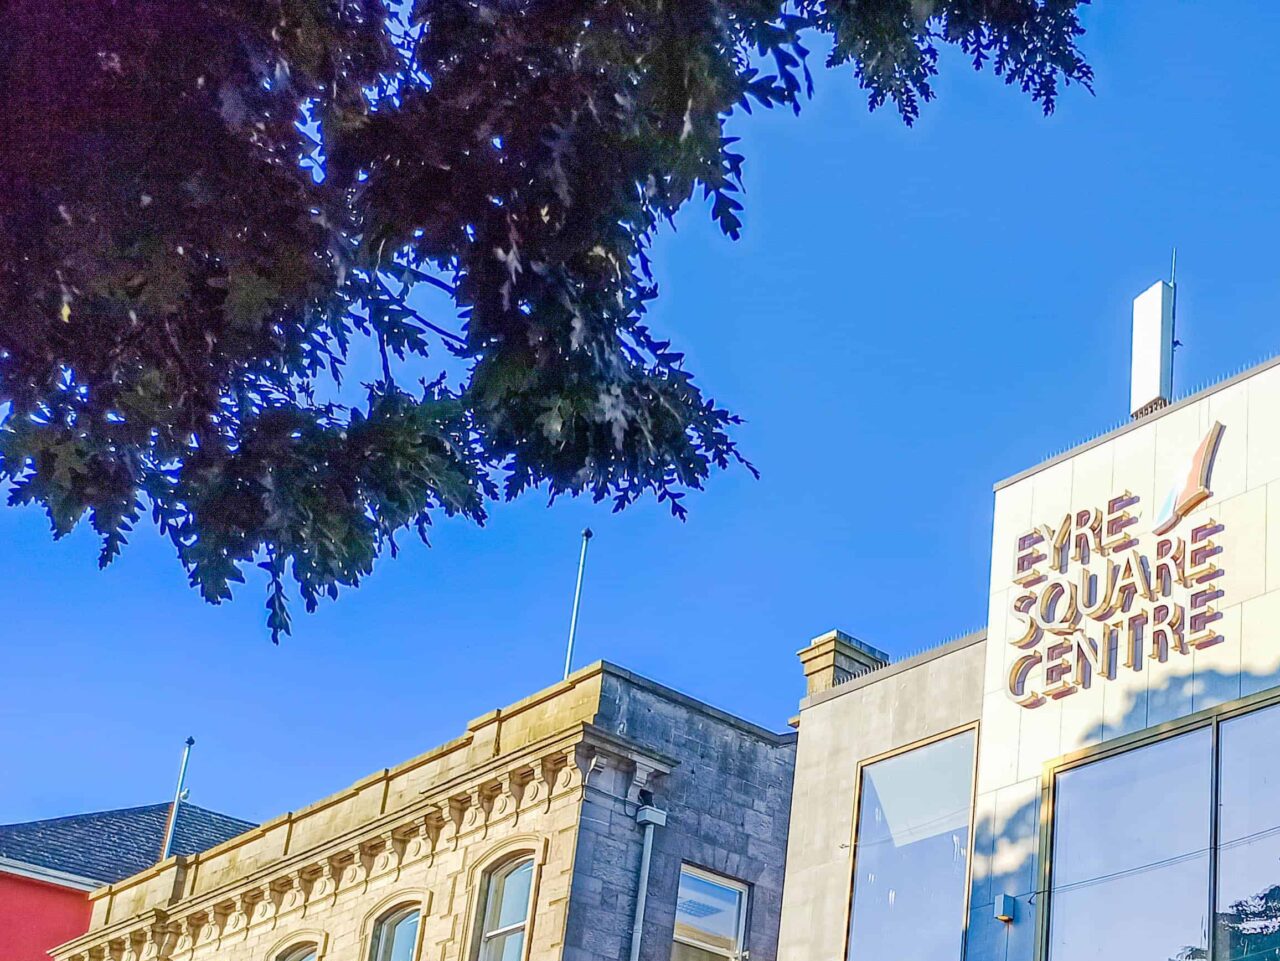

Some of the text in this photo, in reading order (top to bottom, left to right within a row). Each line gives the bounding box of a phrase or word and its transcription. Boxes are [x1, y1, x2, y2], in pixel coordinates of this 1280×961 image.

[1008, 518, 1225, 650] SQUARE
[1013, 490, 1140, 588] EYRE
[1005, 583, 1225, 709] CENTRE
